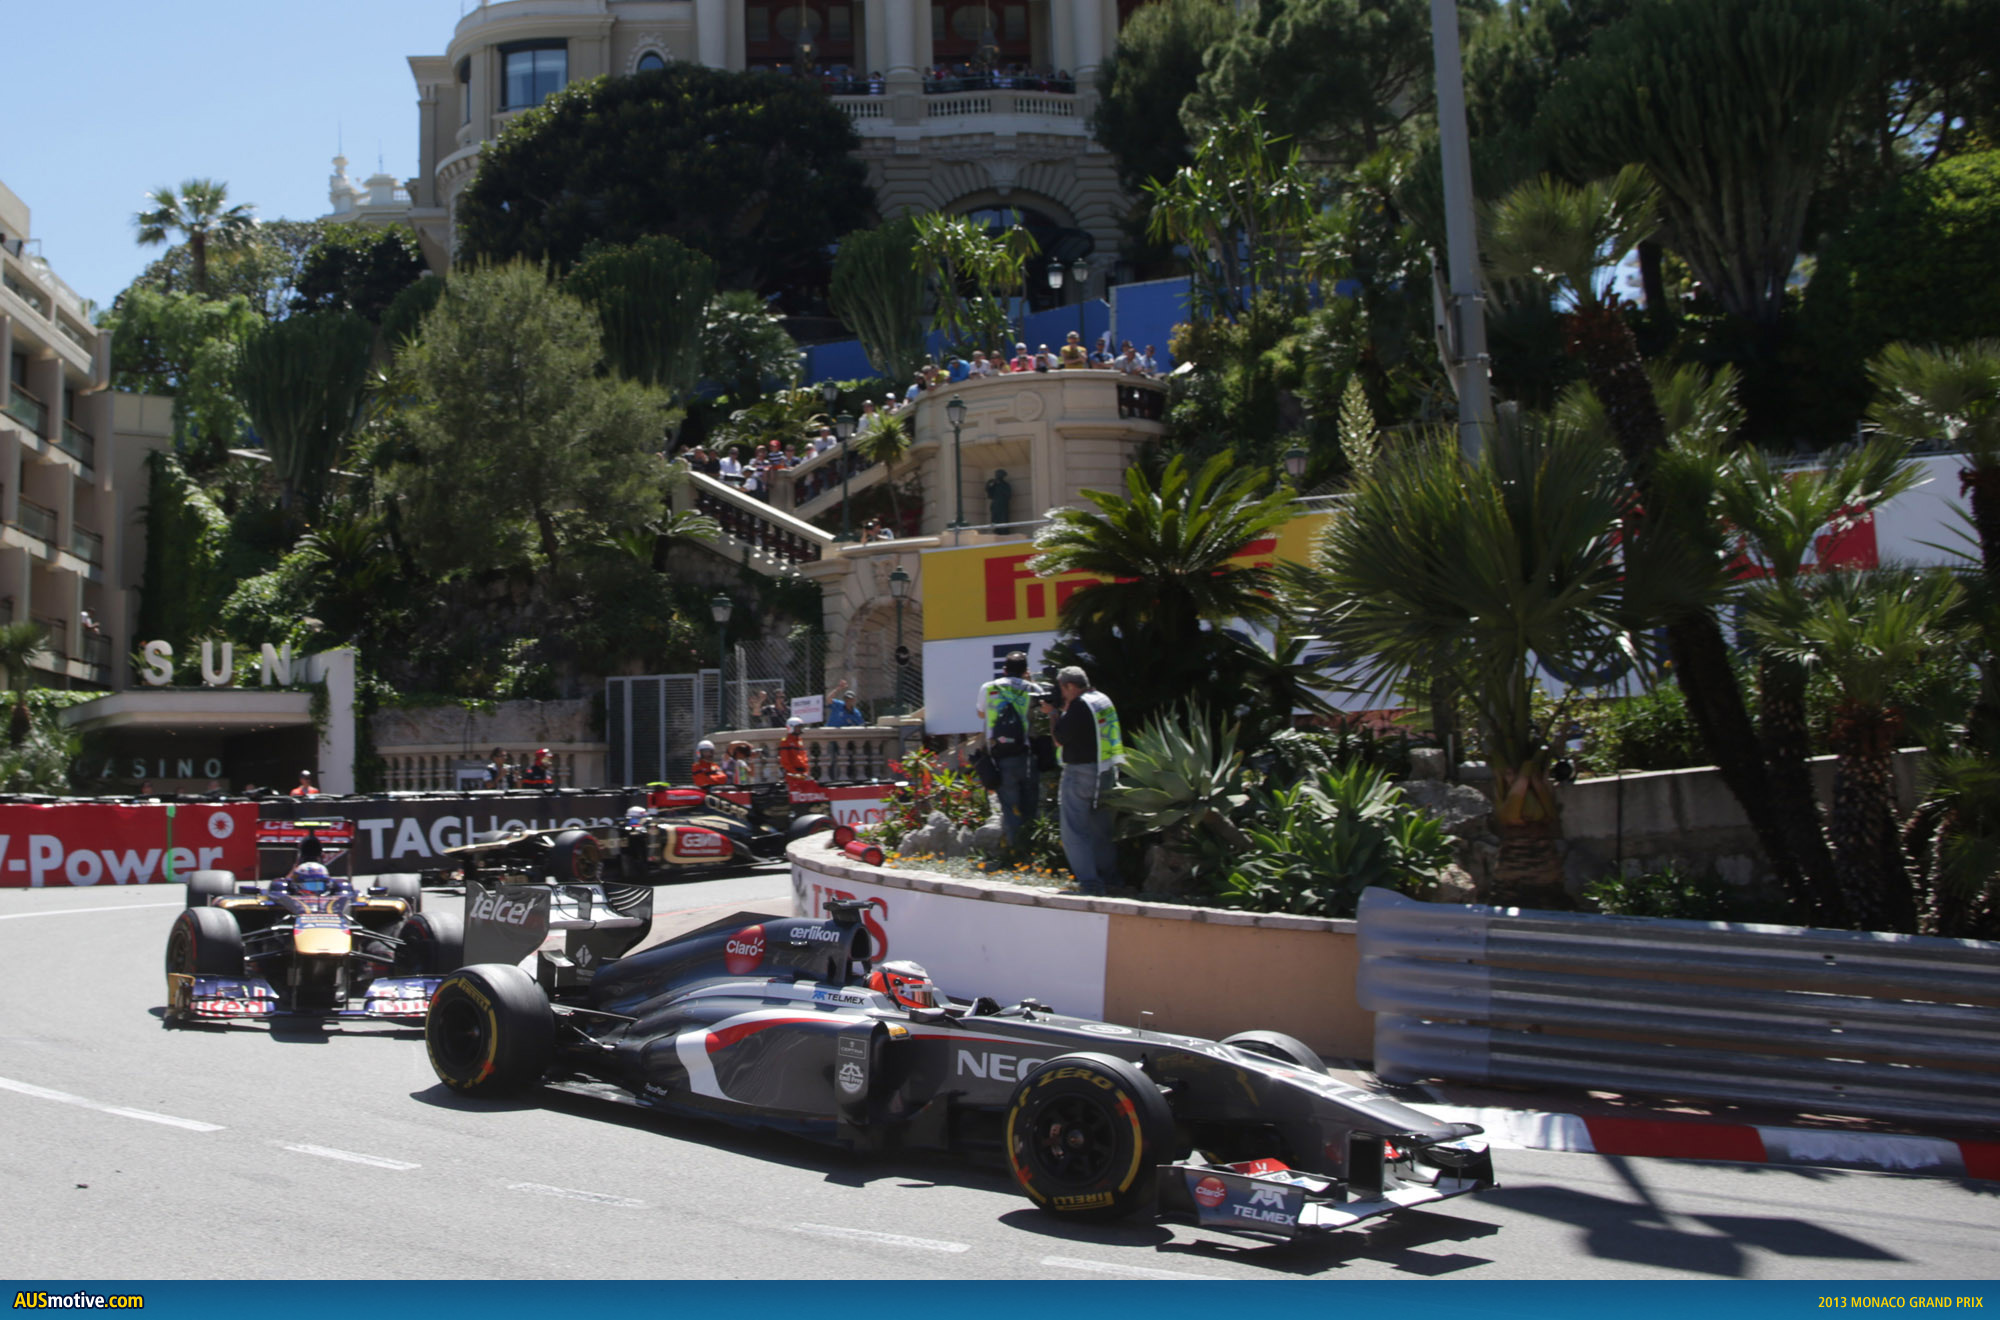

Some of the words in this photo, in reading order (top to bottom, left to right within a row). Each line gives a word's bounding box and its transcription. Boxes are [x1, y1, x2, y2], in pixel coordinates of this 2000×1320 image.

[143, 639, 292, 686] SUN
[470, 892, 536, 925] telcel
[827, 993, 865, 1006] TELMEX
[956, 1050, 1046, 1084] NEC
[1036, 1067, 1116, 1091] ZERO
[1052, 1190, 1115, 1211] PIRELLI
[1232, 1203, 1296, 1227] TELMEX
